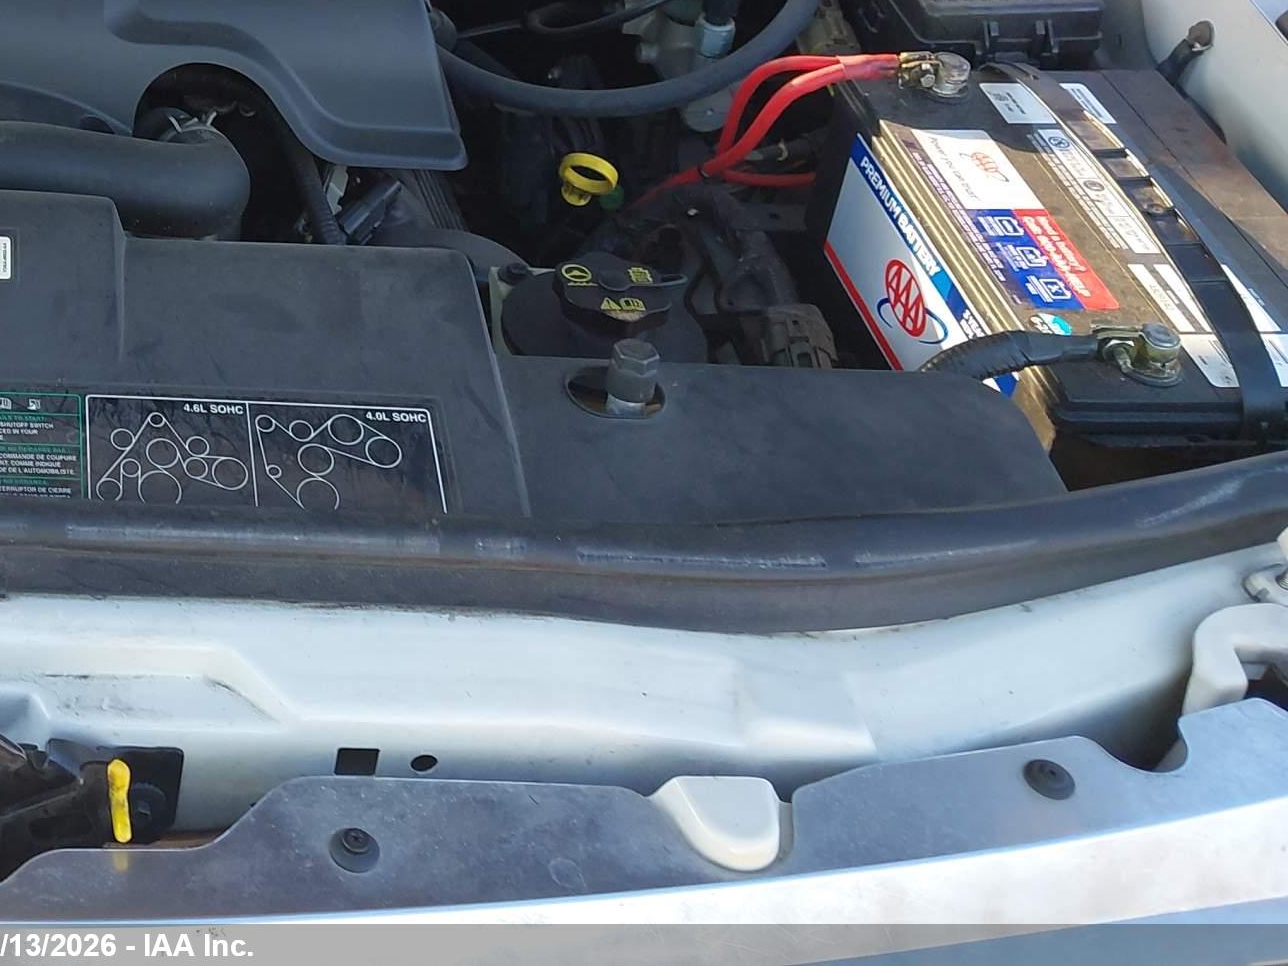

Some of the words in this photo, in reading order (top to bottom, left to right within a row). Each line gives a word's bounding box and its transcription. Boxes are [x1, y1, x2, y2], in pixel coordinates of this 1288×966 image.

[860, 156, 903, 218] PREMIUM
[896, 215, 944, 277] BATTERY
[886, 260, 927, 338] AAA
[183, 403, 208, 414] 4.6L
[210, 404, 244, 416] SOHC
[365, 411, 392, 422] 4.0L
[392, 412, 427, 424] SOHC
